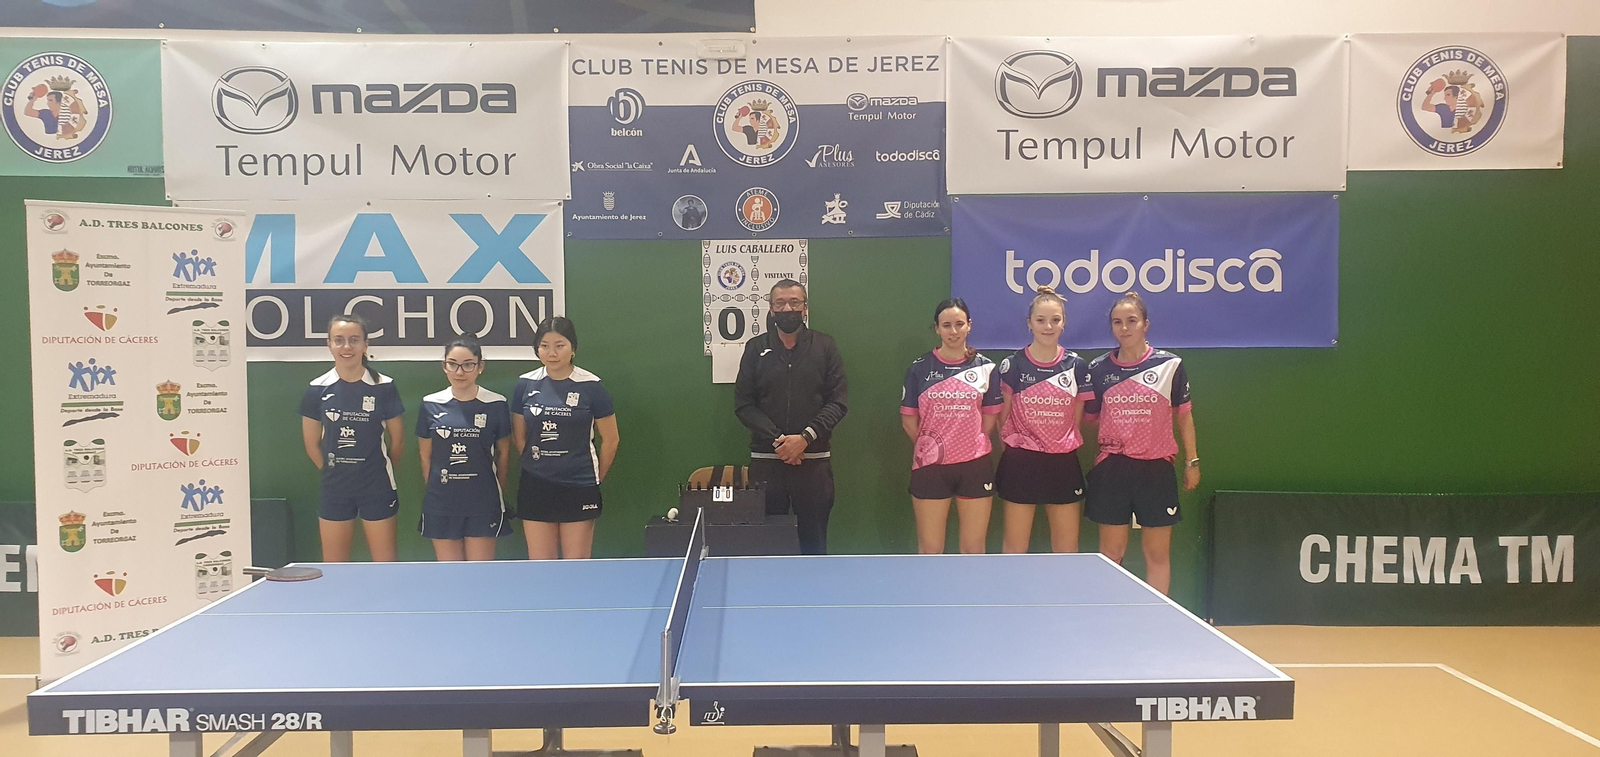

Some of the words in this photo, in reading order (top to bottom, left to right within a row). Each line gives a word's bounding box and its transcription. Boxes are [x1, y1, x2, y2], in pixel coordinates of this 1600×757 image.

[571, 59, 633, 75] CLUB
[640, 58, 708, 75] TENIS
[717, 58, 747, 75] DE
[756, 57, 820, 74] MESA
[828, 56, 859, 73] DE
[867, 55, 940, 73] JEREZ
[4, 72, 24, 106] CLUB
[22, 55, 64, 73] TENIS
[67, 58, 86, 73] DE
[85, 72, 109, 108] MESA
[1402, 67, 1423, 101] CLUB
[1422, 50, 1463, 67] TENIS
[1466, 52, 1484, 68] DE
[1483, 66, 1505, 101] MESA
[716, 97, 732, 124] CLUB
[731, 83, 762, 97] TENIS
[765, 85, 780, 98] DE
[779, 95, 797, 124] MESA
[848, 111, 882, 122] Tempul
[888, 112, 916, 120] Motor
[611, 127, 643, 137] belcón
[34, 146, 82, 159] JEREZ
[818, 144, 854, 162] Plus
[997, 127, 1142, 169] Tempul
[1171, 128, 1295, 159] Motor
[1429, 140, 1474, 153] JEREZ
[216, 143, 362, 185] Tempul
[391, 144, 517, 176] Motor
[738, 154, 775, 164] JEREZ
[630, 213, 647, 221] Jerez
[79, 219, 104, 229] A.D.
[107, 220, 139, 230] TRES
[141, 221, 203, 232] BALCONES
[716, 244, 737, 253] LUIS
[740, 244, 794, 253] CABALLERO
[85, 262, 131, 270] Ayuntamiento
[172, 282, 218, 290] Extremadura
[246, 295, 546, 338] OLCHON
[718, 306, 745, 341] 0
[42, 336, 103, 345] DIPUTACIÓN
[105, 336, 116, 344] DE
[118, 335, 159, 344] CÁCERES
[186, 390, 228, 398] Ayuntamiento
[131, 460, 187, 471] DIPUTACIÓN
[189, 459, 199, 468] DE
[201, 458, 238, 467] CÁCERES
[91, 518, 137, 527] Ayuntamiento
[1300, 534, 1482, 584] CHEMA
[1498, 535, 1575, 584] TM
[52, 602, 112, 616] DIPUTACIÓN
[114, 599, 125, 609] DE
[128, 595, 167, 607] CÁCERES
[91, 633, 116, 644] A.D.
[118, 629, 150, 641] TRES
[1135, 696, 1258, 721] TIBHAR
[62, 708, 190, 734] TIBHAR
[195, 713, 265, 731] SMASH
[271, 712, 322, 730] 28/R
